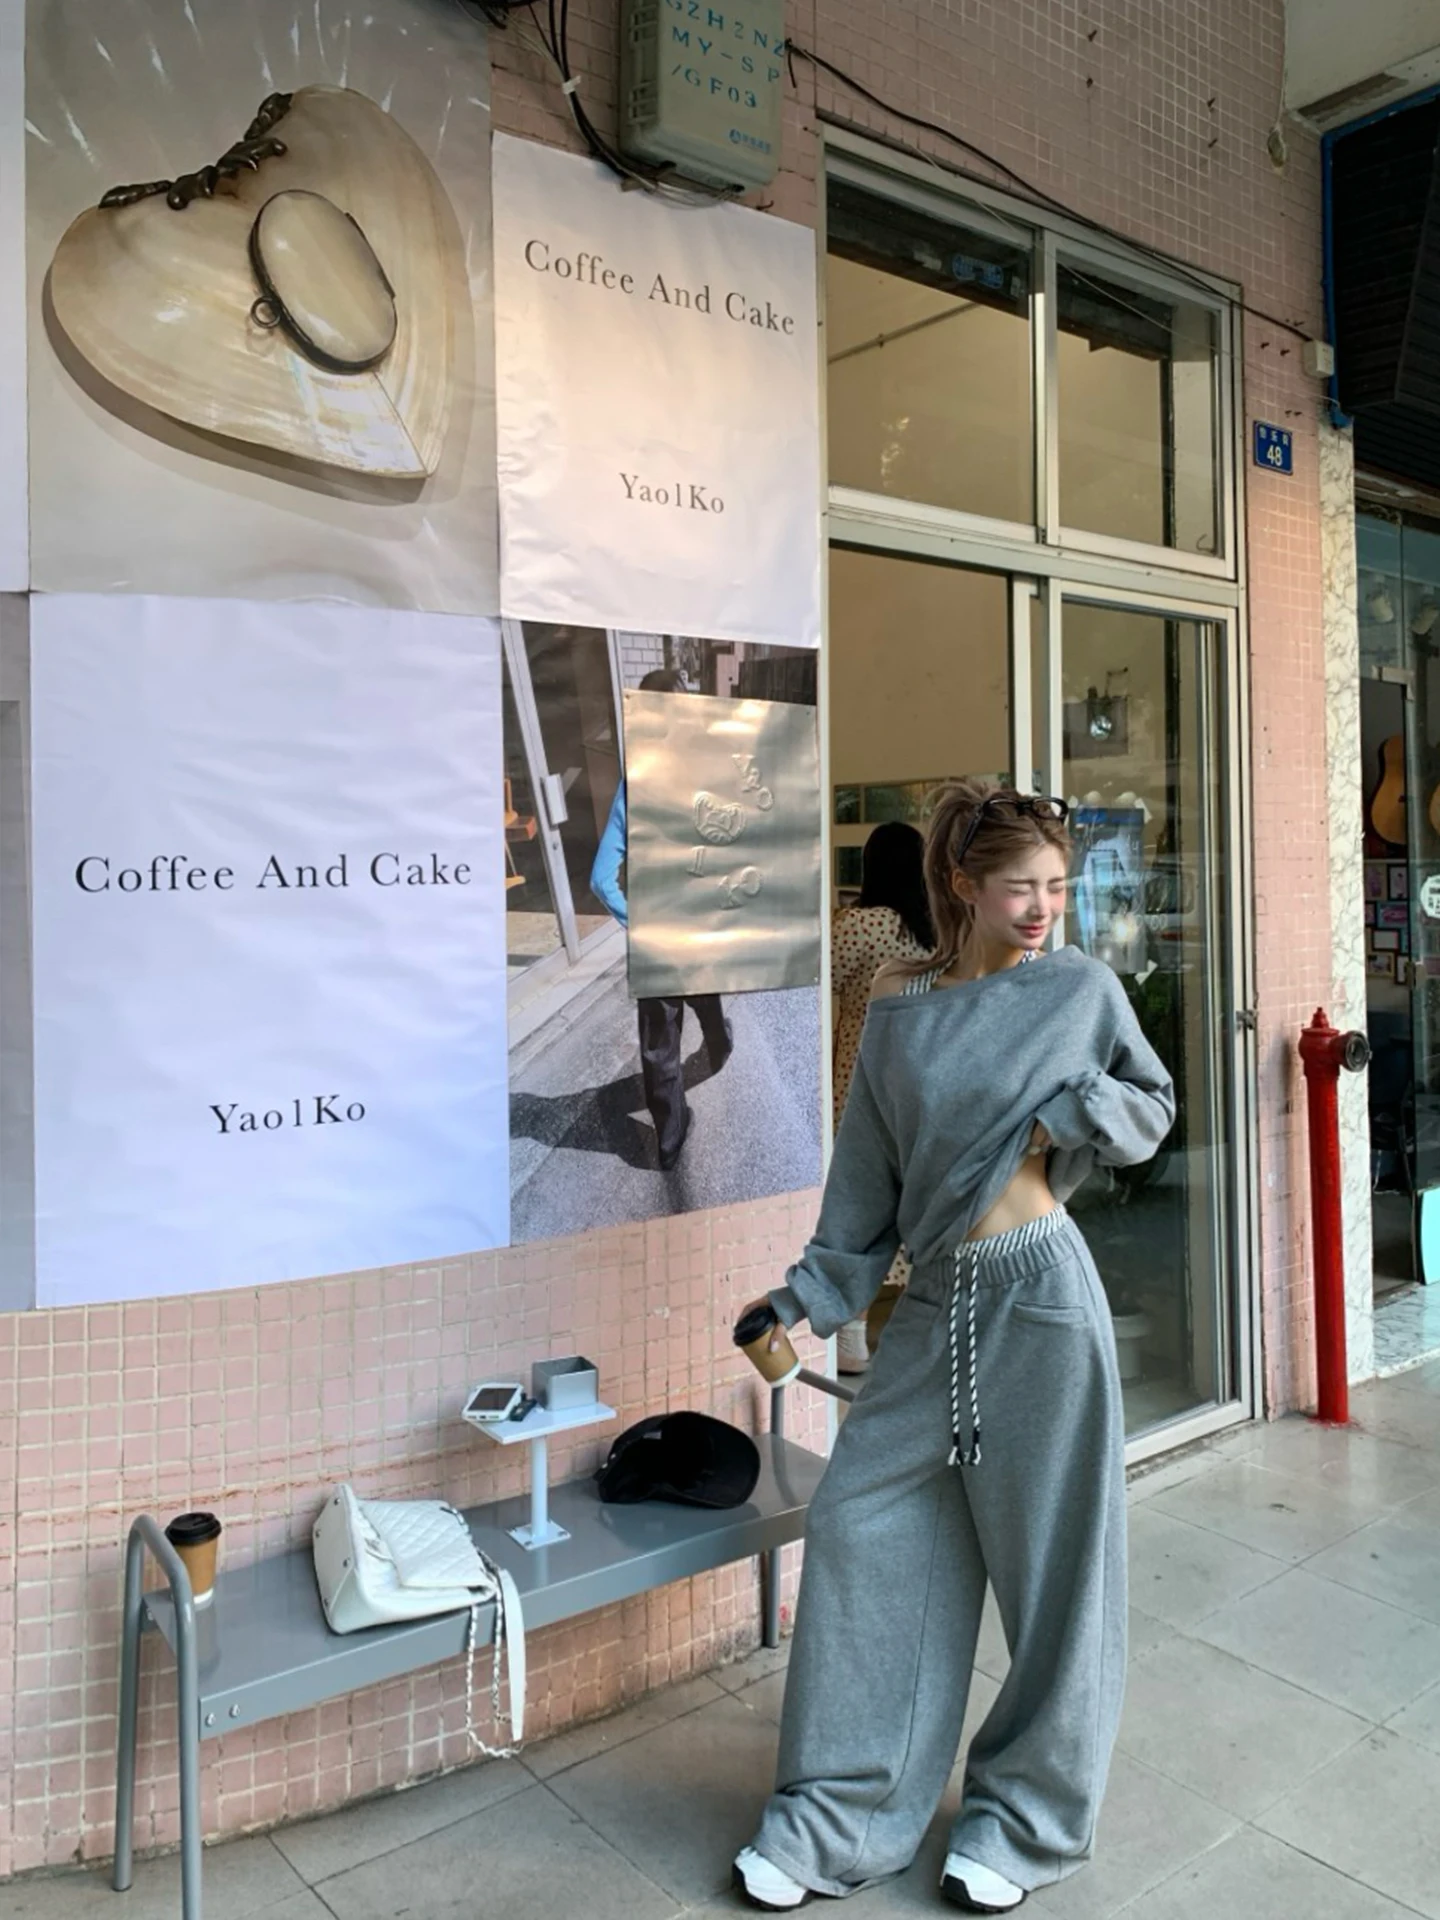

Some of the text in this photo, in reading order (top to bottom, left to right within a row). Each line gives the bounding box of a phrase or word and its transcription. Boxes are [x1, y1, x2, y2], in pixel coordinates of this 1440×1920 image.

[525, 240, 793, 334] Coffee And Cake
[1267, 445, 1282, 466] 48
[75, 853, 471, 893] Coffee And Cake
